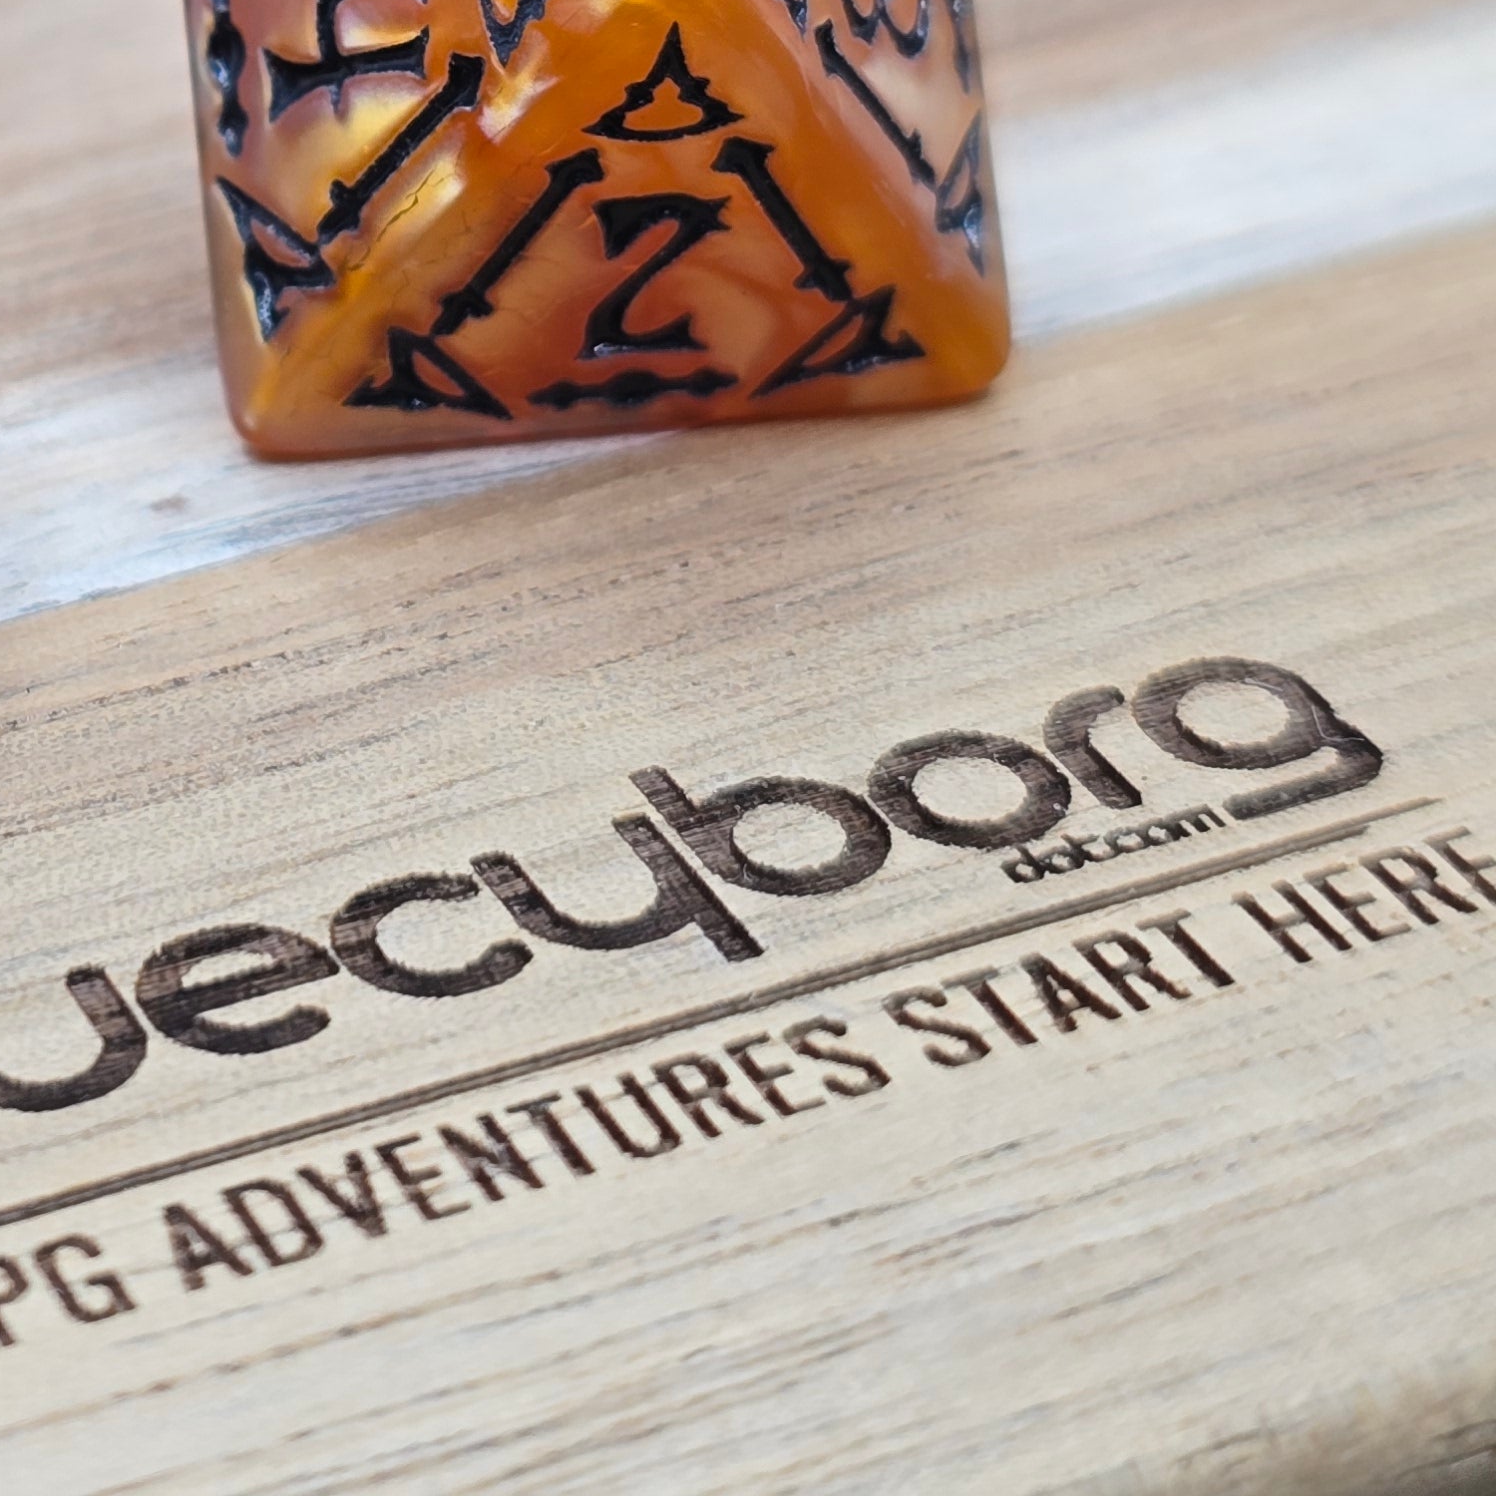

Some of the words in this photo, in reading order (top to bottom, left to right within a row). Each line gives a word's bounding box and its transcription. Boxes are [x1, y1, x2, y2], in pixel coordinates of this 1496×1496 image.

[574, 192, 732, 360] 2
[162, 1014, 894, 1292] ADVENTURES
[881, 908, 1238, 1068] START
[1230, 824, 1495, 964] HERE
